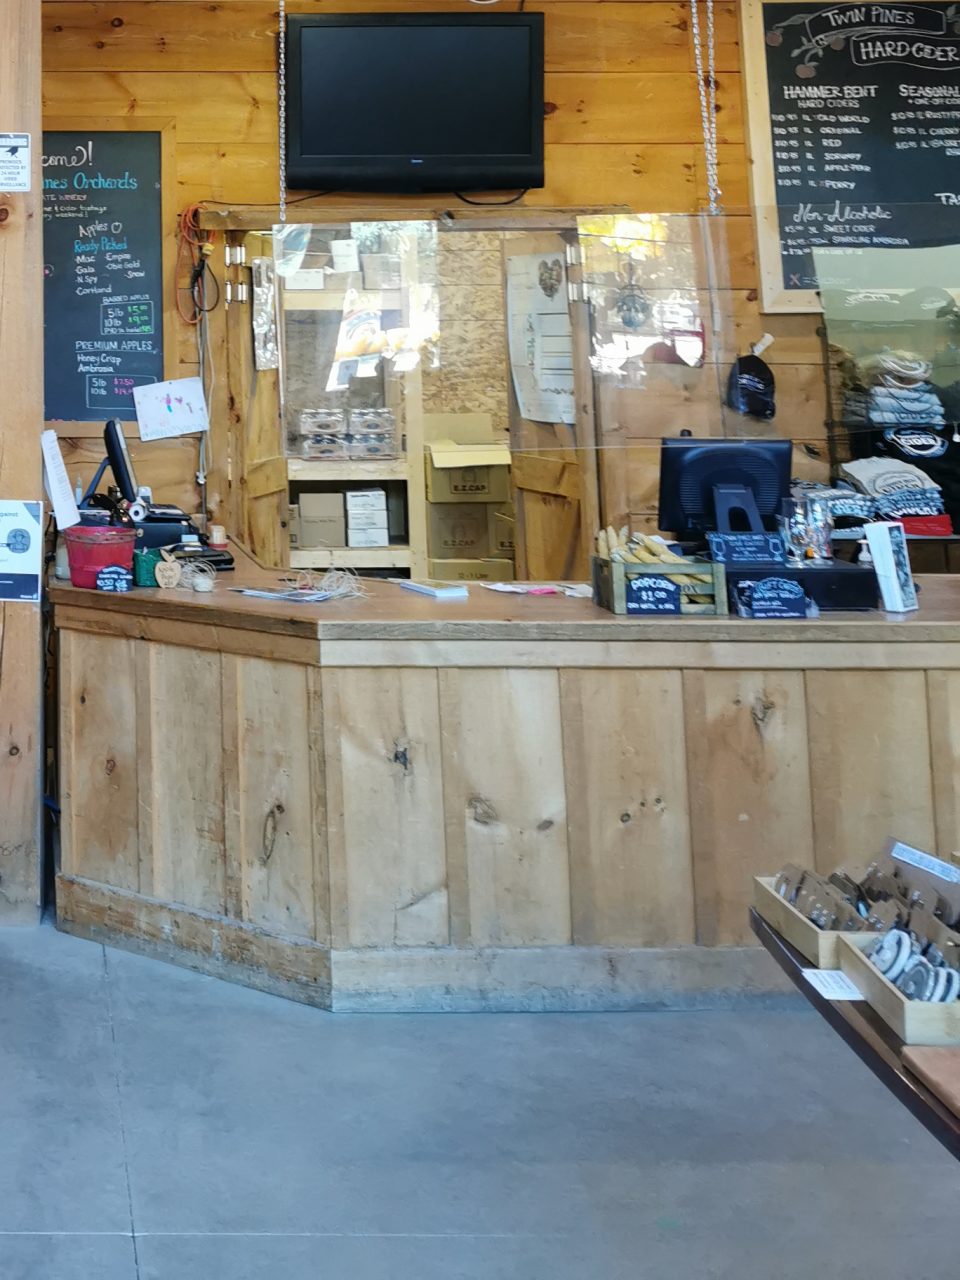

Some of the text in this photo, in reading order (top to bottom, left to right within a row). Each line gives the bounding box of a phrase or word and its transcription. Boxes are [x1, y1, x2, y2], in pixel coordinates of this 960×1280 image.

[821, 5, 916, 26] TWIN PINES
[860, 40, 960, 61] HARD CIDER
[783, 85, 879, 100] HAMMER BENT
[898, 84, 960, 98] SEASONAL
[798, 99, 860, 108] HARD CIDERS
[822, 138, 842, 148] RED
[73, 171, 138, 190] Orchards
[824, 180, 856, 190] PERRY
[792, 200, 893, 222] Non-Alcoholic
[78, 220, 108, 238] Apples
[823, 224, 850, 234] SWEET
[852, 224, 876, 233] CIDER
[74, 236, 128, 254] Ready Picked
[84, 276, 98, 285] Spy
[76, 284, 112, 296] Cortland
[75, 340, 153, 350] PREMIUM APPLES
[76, 353, 122, 366] Honey Crisp
[77, 364, 115, 373] Ambrosia
[453, 484, 486, 492] E.Z.CAP
[630, 578, 676, 592] POPCORN
